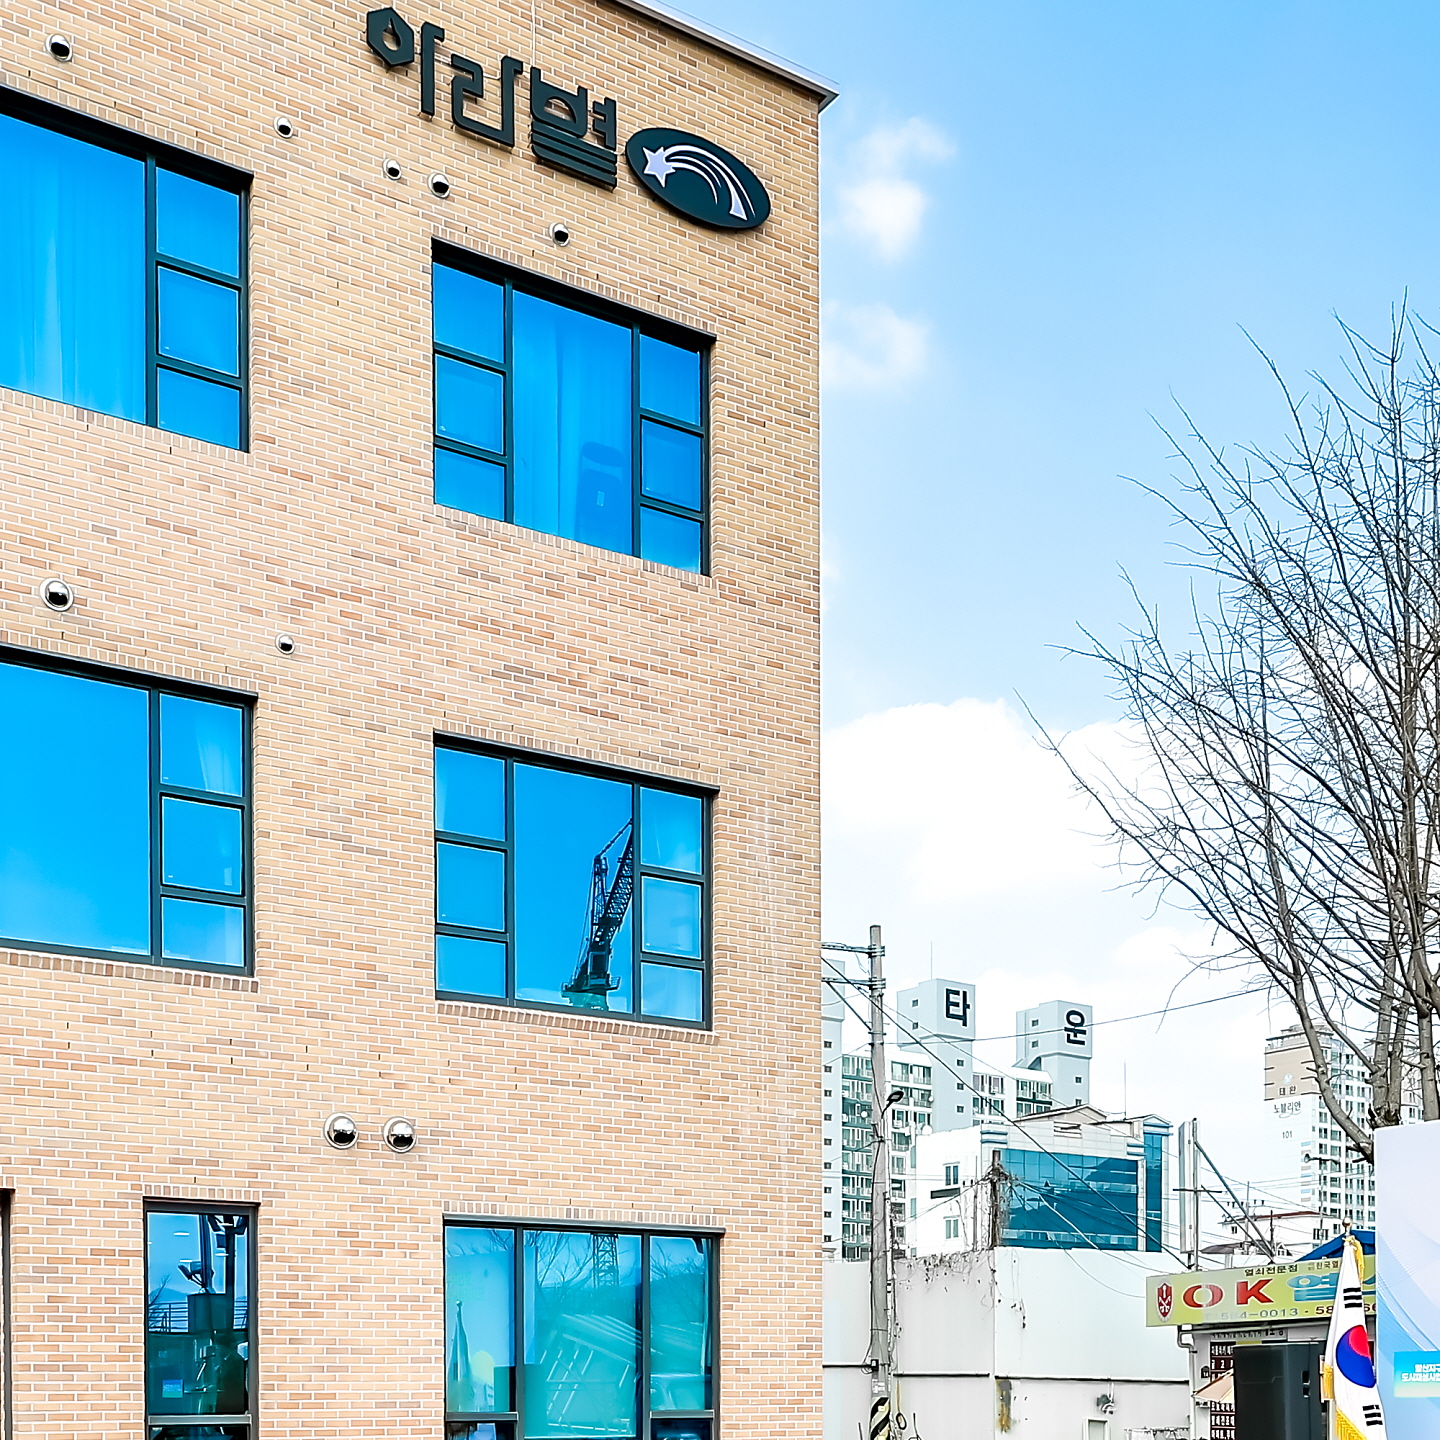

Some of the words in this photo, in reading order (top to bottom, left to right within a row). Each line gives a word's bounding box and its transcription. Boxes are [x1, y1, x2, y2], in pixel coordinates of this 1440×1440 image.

[365, 7, 618, 192] 아라별
[1244, 1264, 1299, 1276] 열쇠전문점
[1183, 1278, 1275, 1308] OK
